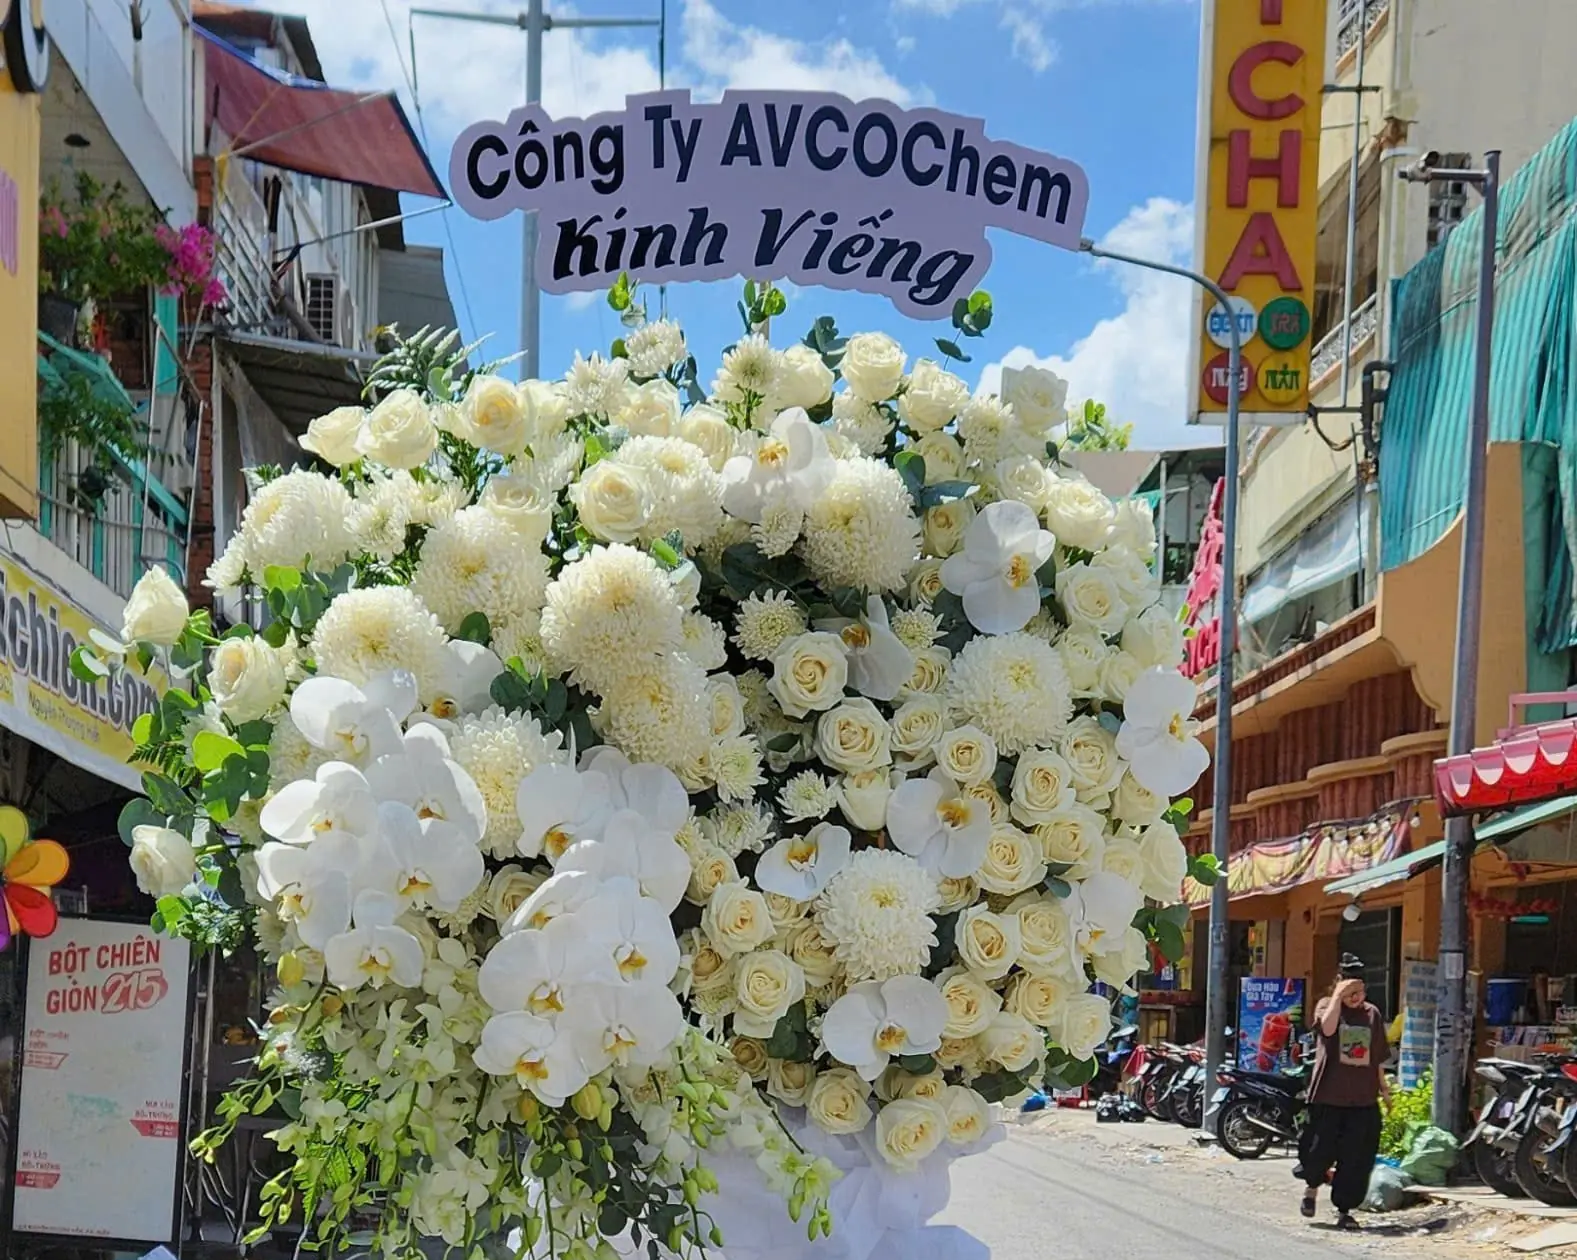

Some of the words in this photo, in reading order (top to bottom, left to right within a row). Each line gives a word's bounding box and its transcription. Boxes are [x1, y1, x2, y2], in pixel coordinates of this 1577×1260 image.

[466, 119, 624, 199] Công
[644, 104, 703, 183] Ty
[720, 102, 1074, 225] AVCOChem
[552, 206, 729, 281] Kính
[753, 207, 977, 307] Viếng
[48, 941, 91, 980] BỘT
[96, 934, 161, 970] CHIÊN
[101, 968, 164, 1015] 215
